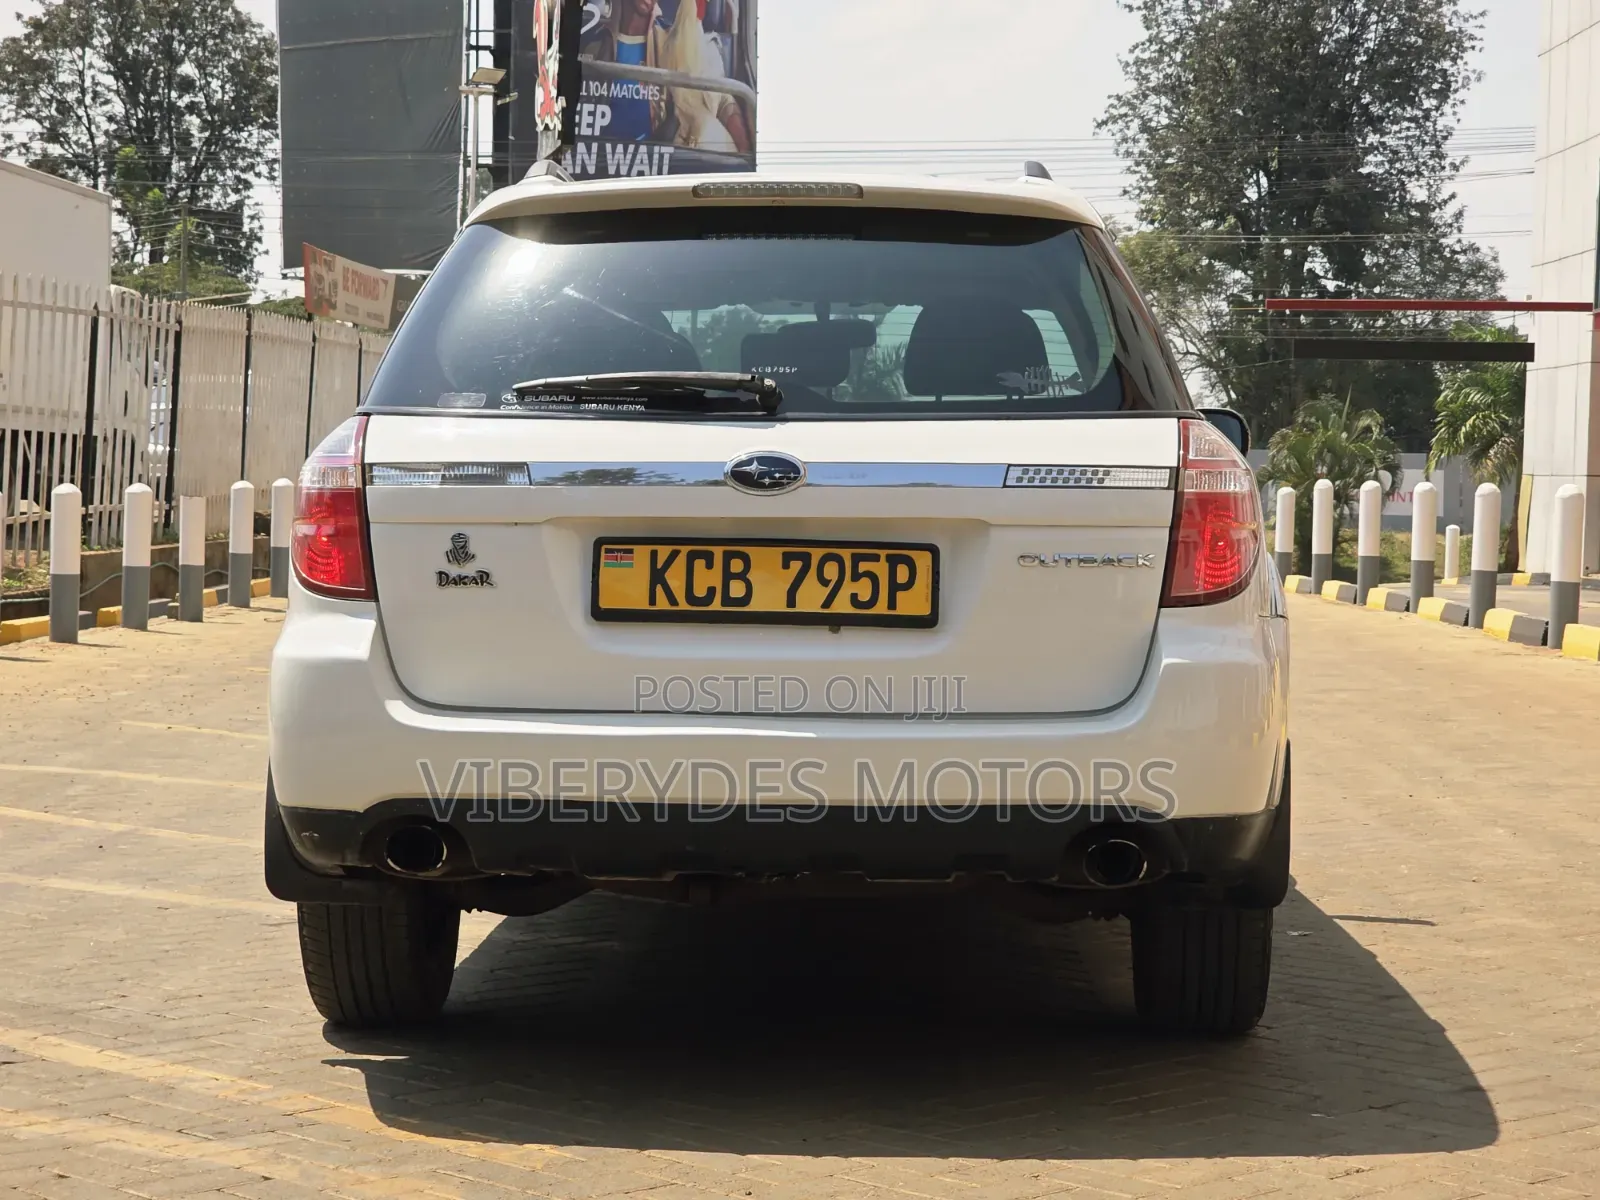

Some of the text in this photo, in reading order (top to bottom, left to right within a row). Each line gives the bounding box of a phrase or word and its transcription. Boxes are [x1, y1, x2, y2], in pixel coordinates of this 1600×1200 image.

[589, 81, 608, 97] 104
[609, 82, 660, 100] MATCHES
[605, 143, 675, 176] WAIT
[1017, 553, 1156, 568] OUTBACK
[435, 569, 496, 587] DAKAR
[648, 549, 754, 608] KCB
[781, 551, 918, 611] 795P
